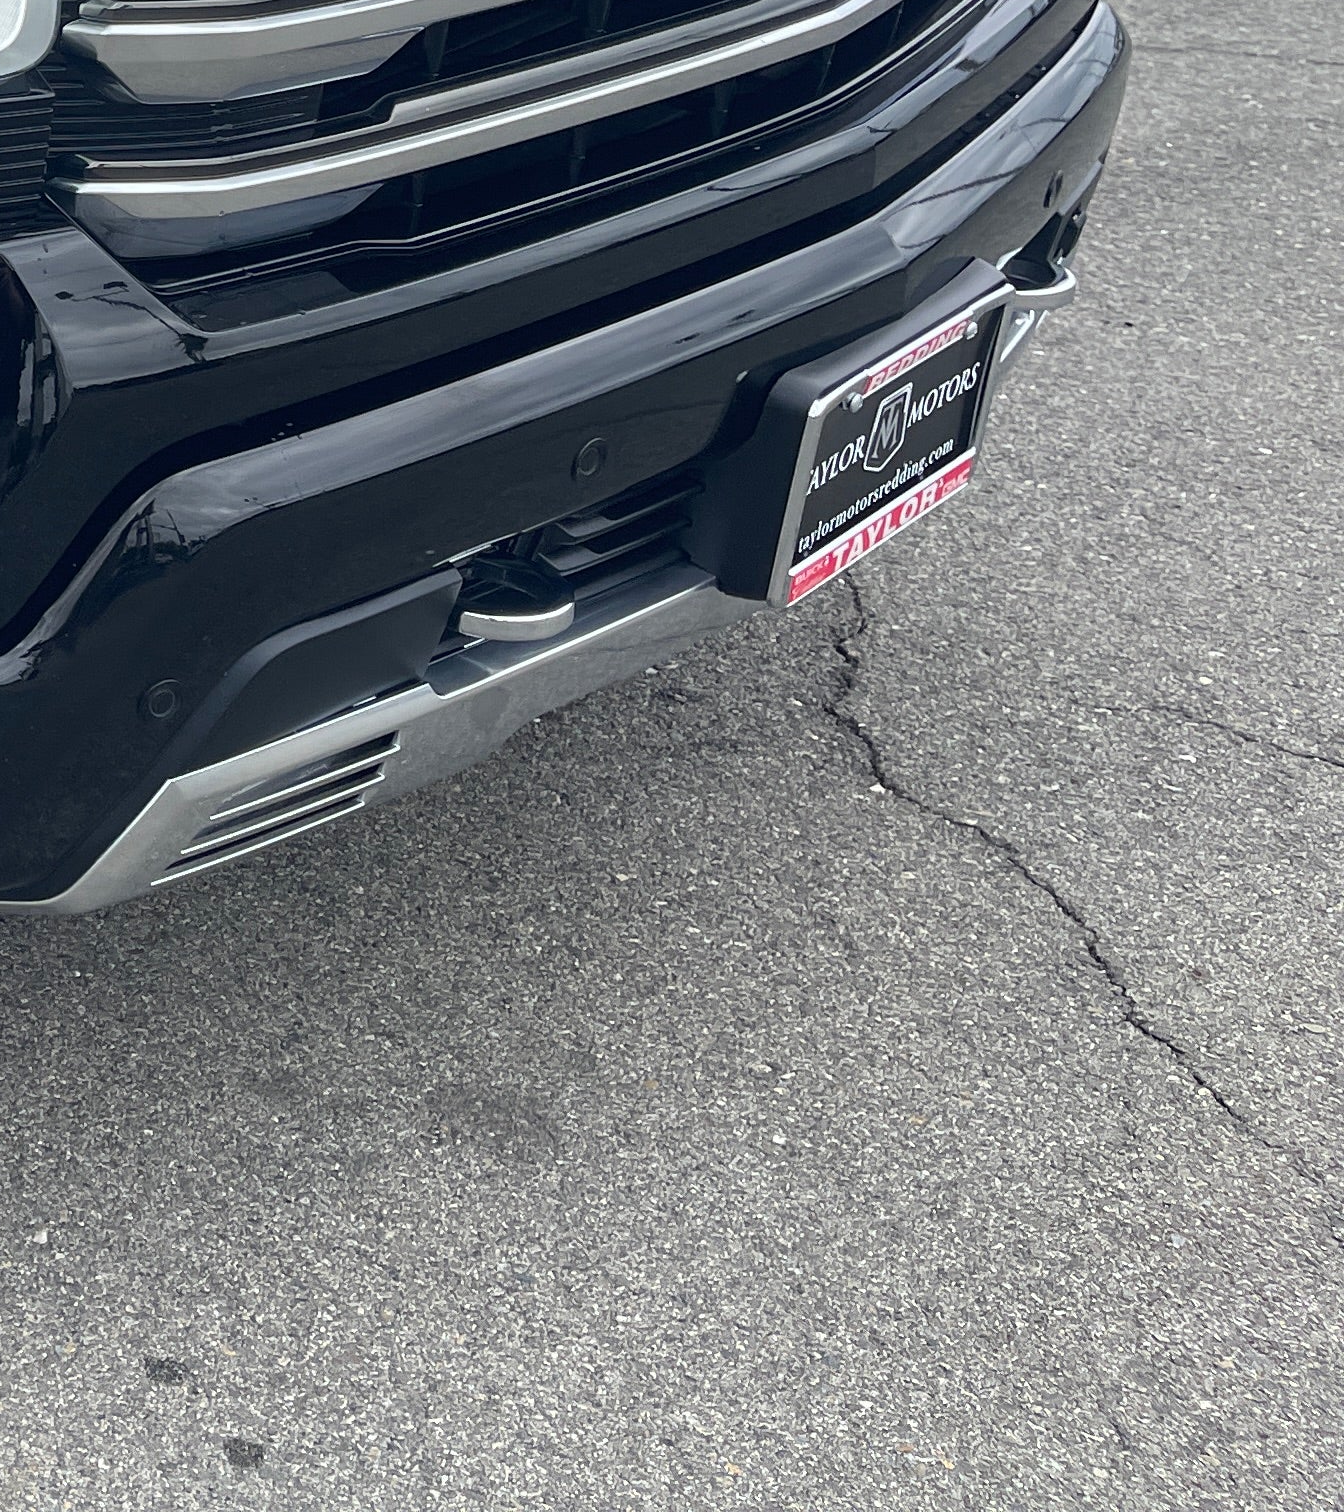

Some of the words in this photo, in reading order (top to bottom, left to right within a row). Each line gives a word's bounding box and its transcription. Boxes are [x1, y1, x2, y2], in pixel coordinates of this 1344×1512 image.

[867, 320, 968, 393] REDDING
[806, 434, 866, 496] AYLOR
[906, 361, 981, 428] MOTORS
[798, 438, 954, 553] taylormotorsredding.com
